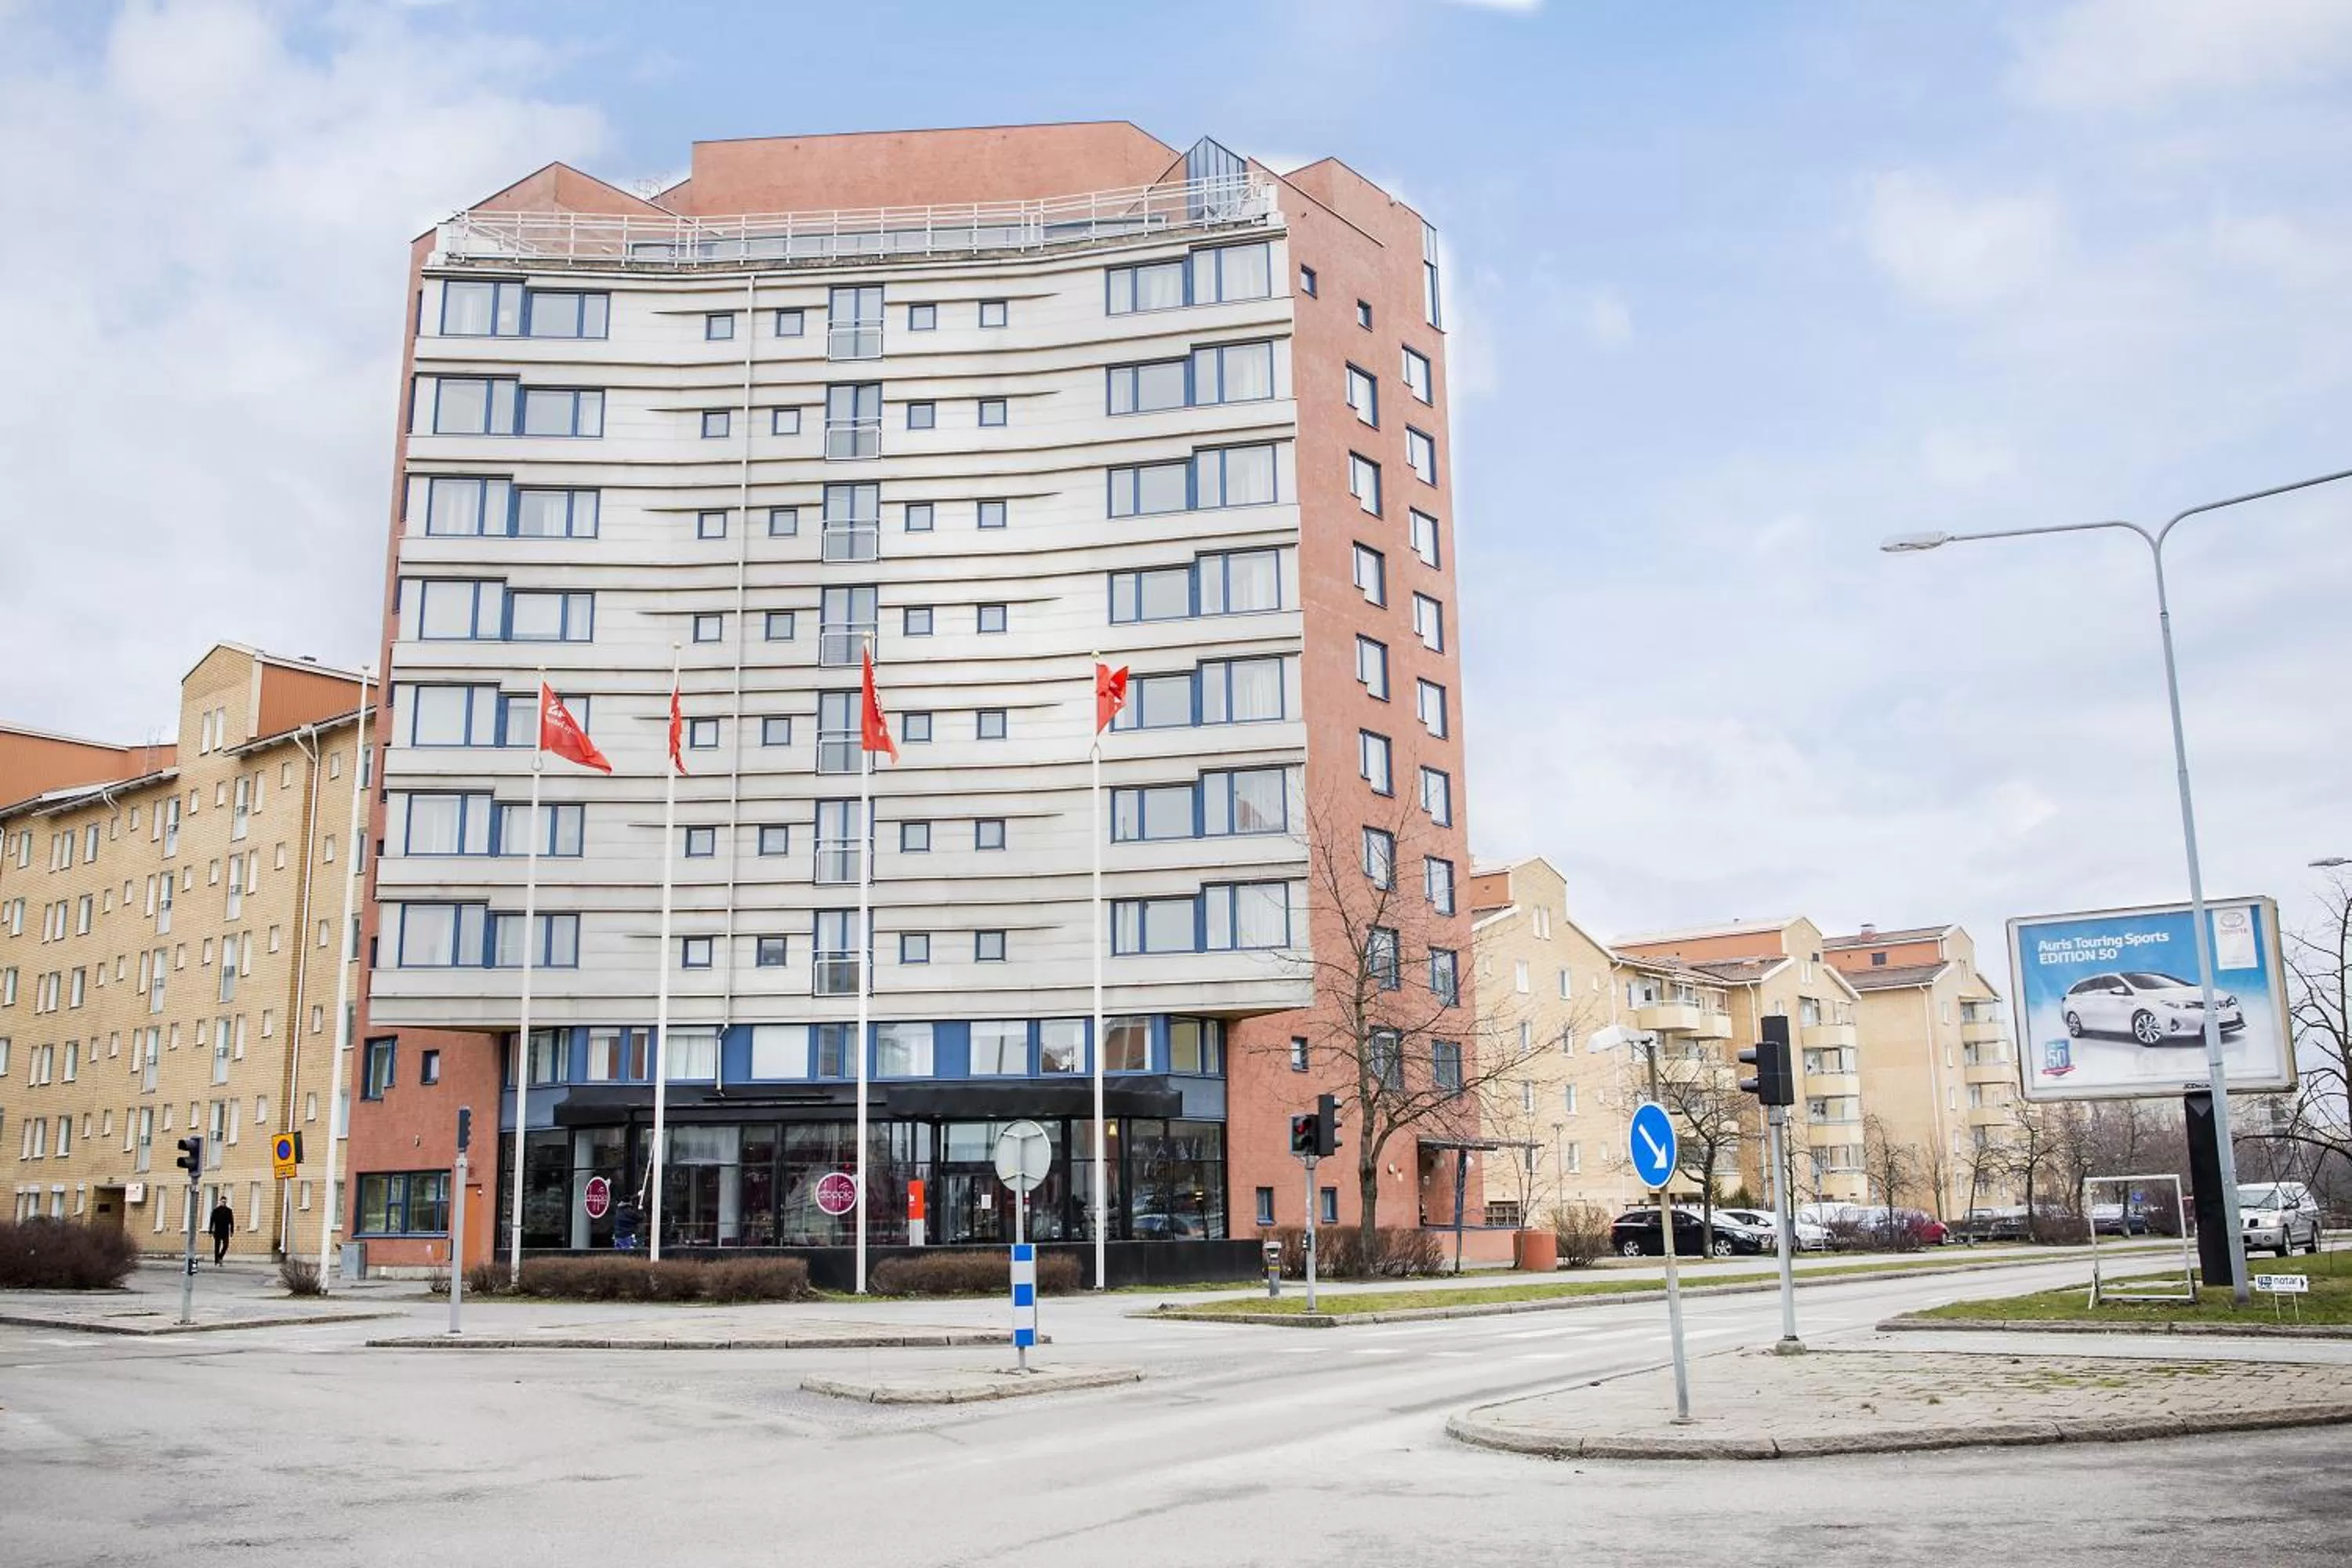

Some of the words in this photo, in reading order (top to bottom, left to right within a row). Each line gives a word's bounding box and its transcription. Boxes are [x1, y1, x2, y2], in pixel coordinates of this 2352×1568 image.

[2038, 940, 2072, 952] Auris
[2074, 935, 2123, 949] Touring
[2124, 931, 2170, 946] Sports
[2039, 949, 2096, 964] EDITION
[2098, 948, 2118, 960] 50
[2046, 1050, 2067, 1067] 50
